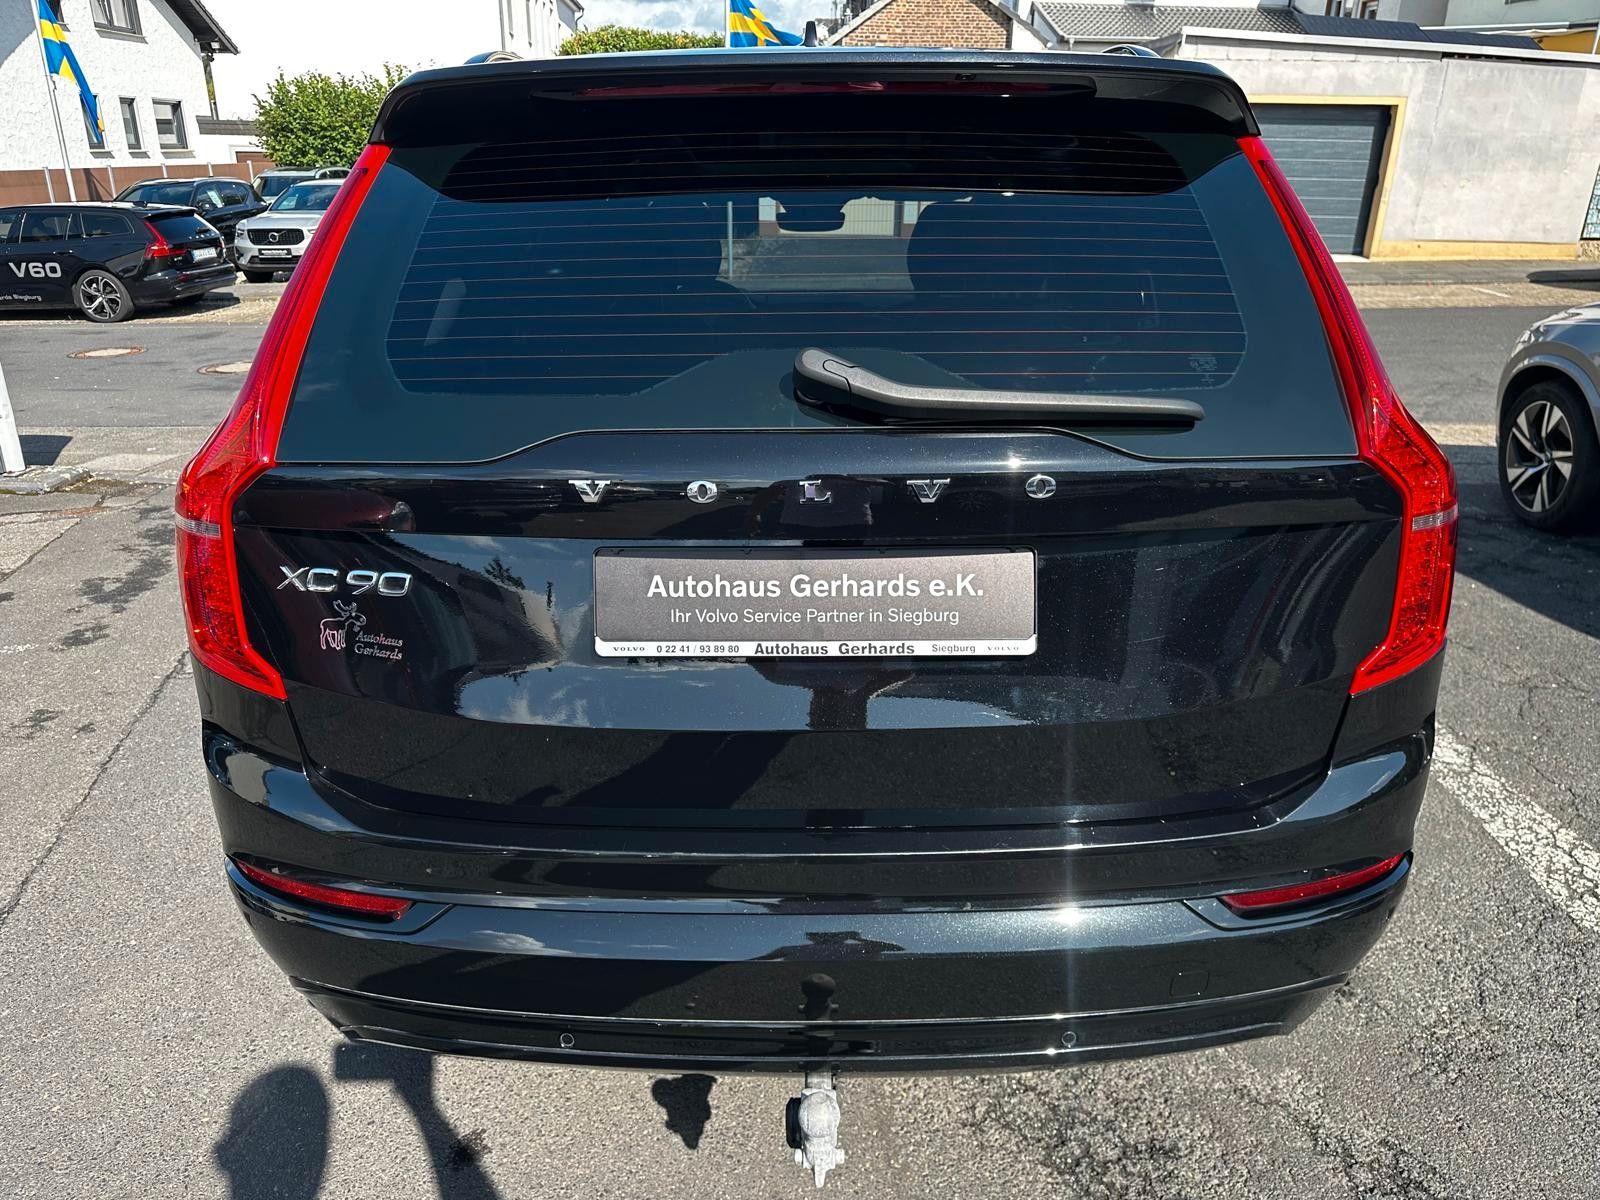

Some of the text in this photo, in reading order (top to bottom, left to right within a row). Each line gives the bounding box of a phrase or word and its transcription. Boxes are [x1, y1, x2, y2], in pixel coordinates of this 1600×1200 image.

[8, 262, 62, 278] V60
[568, 475, 1058, 505] VOLVO
[647, 573, 984, 598] Autohaus Gerhards e.K.
[670, 608, 959, 625] Ihr Volvo Service Partner in Siegburg
[355, 631, 403, 647] Autohaus
[354, 643, 402, 660] Gerhards
[754, 643, 829, 655] Autohaus
[838, 642, 915, 655] Gerhards
[931, 643, 976, 654] Siegburg
